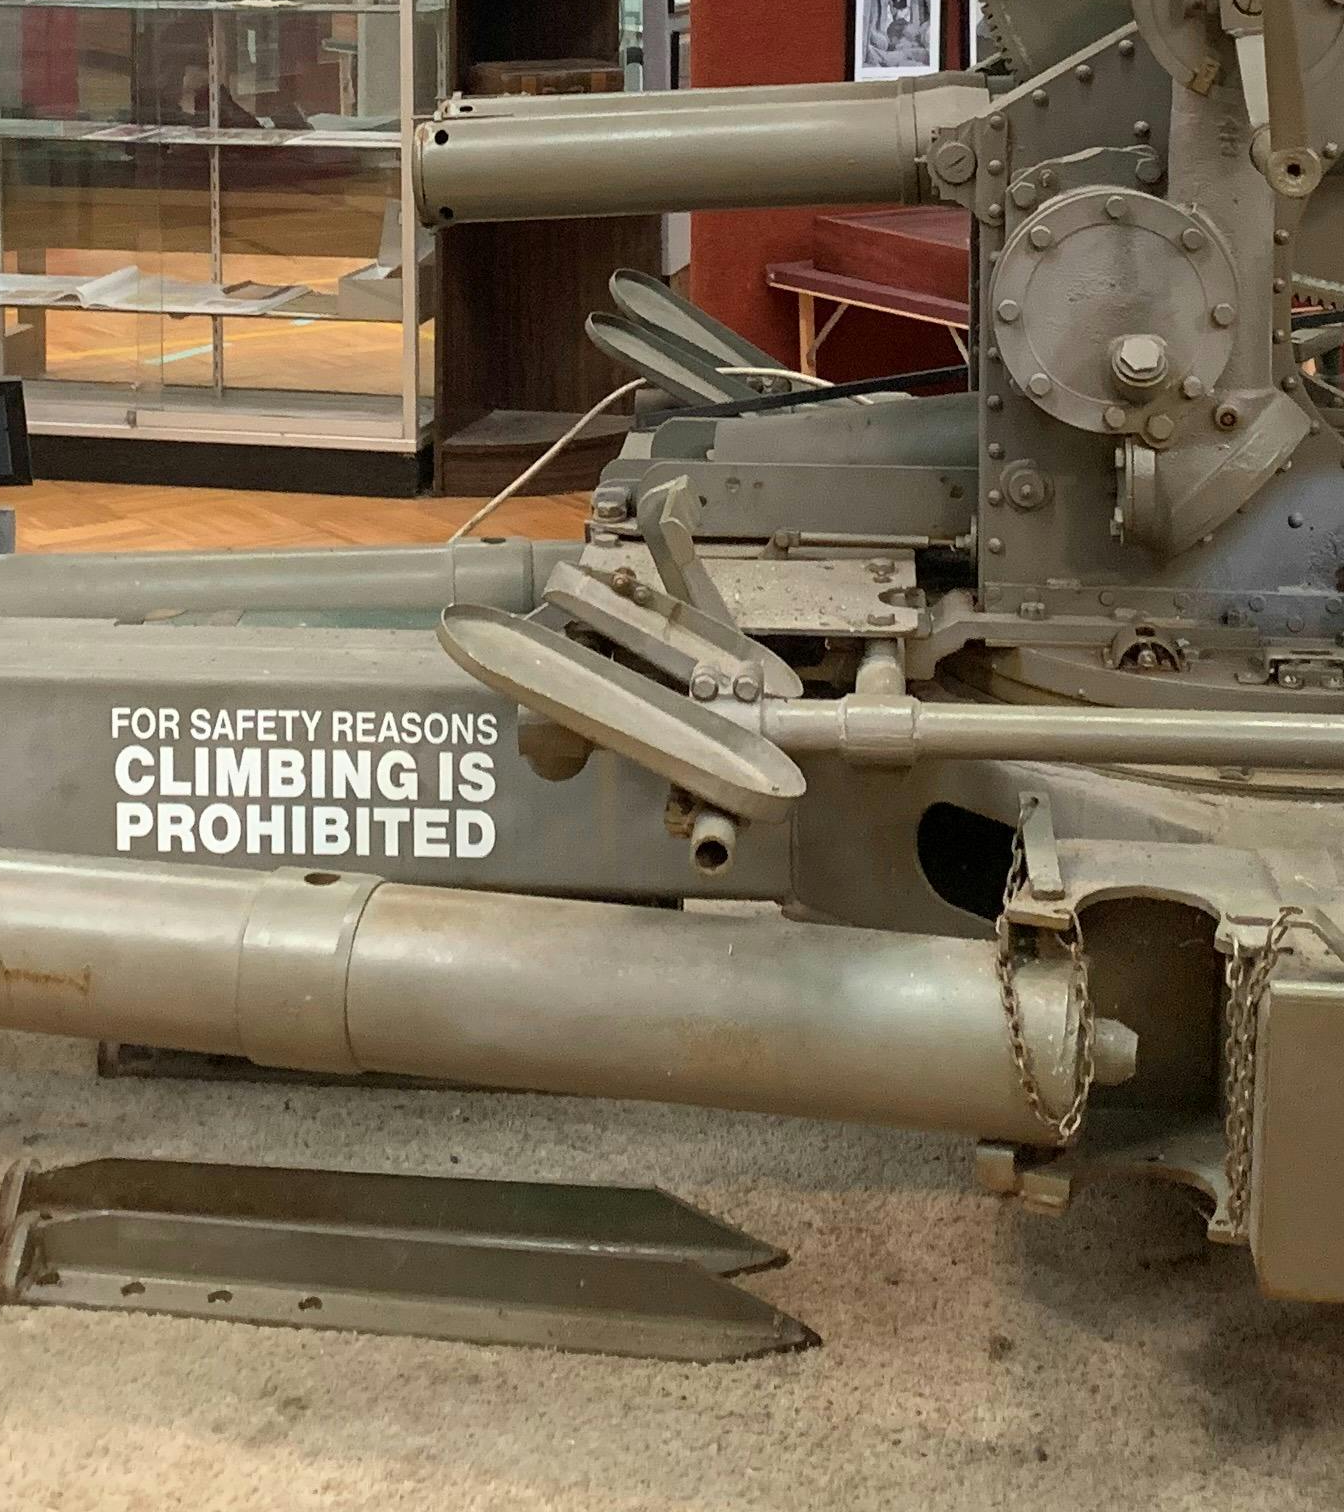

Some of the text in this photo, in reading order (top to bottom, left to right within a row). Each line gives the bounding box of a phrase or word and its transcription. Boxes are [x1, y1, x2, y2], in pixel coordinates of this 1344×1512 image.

[112, 707, 498, 745] FOR SAFETY REASONS
[115, 744, 497, 802] CLIMBING IS
[116, 801, 497, 859] PROHIBITED
